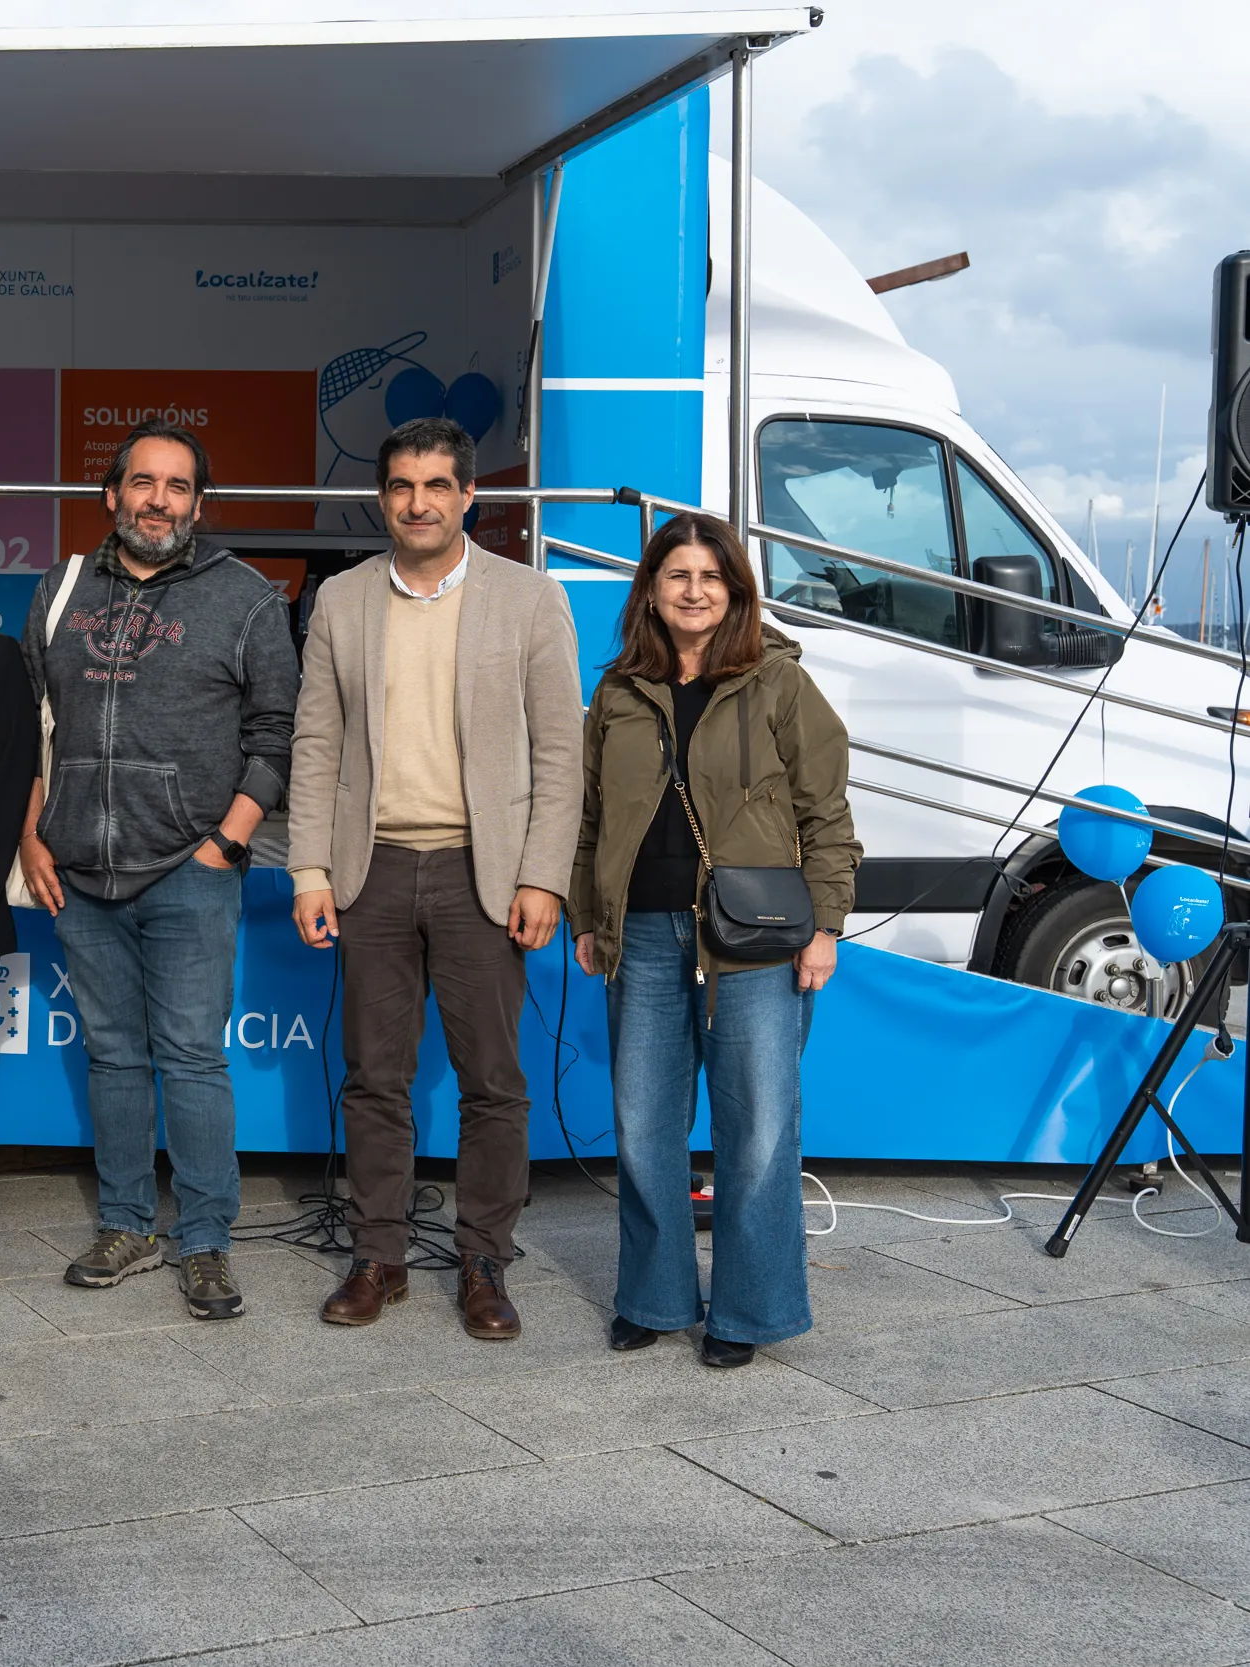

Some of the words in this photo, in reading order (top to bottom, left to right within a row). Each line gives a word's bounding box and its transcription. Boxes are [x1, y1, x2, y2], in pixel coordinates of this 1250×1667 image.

[0, 270, 46, 282] XUNTA
[196, 270, 319, 288] Localízate!
[20, 284, 75, 296] GALICIA
[289, 294, 308, 302] local
[84, 440, 121, 453] Atopa
[84, 471, 91, 480] a
[100, 641, 132, 651] CAFE
[85, 670, 135, 680] MUNICH
[47, 1011, 87, 1047] D
[223, 1012, 316, 1050] ICIA
